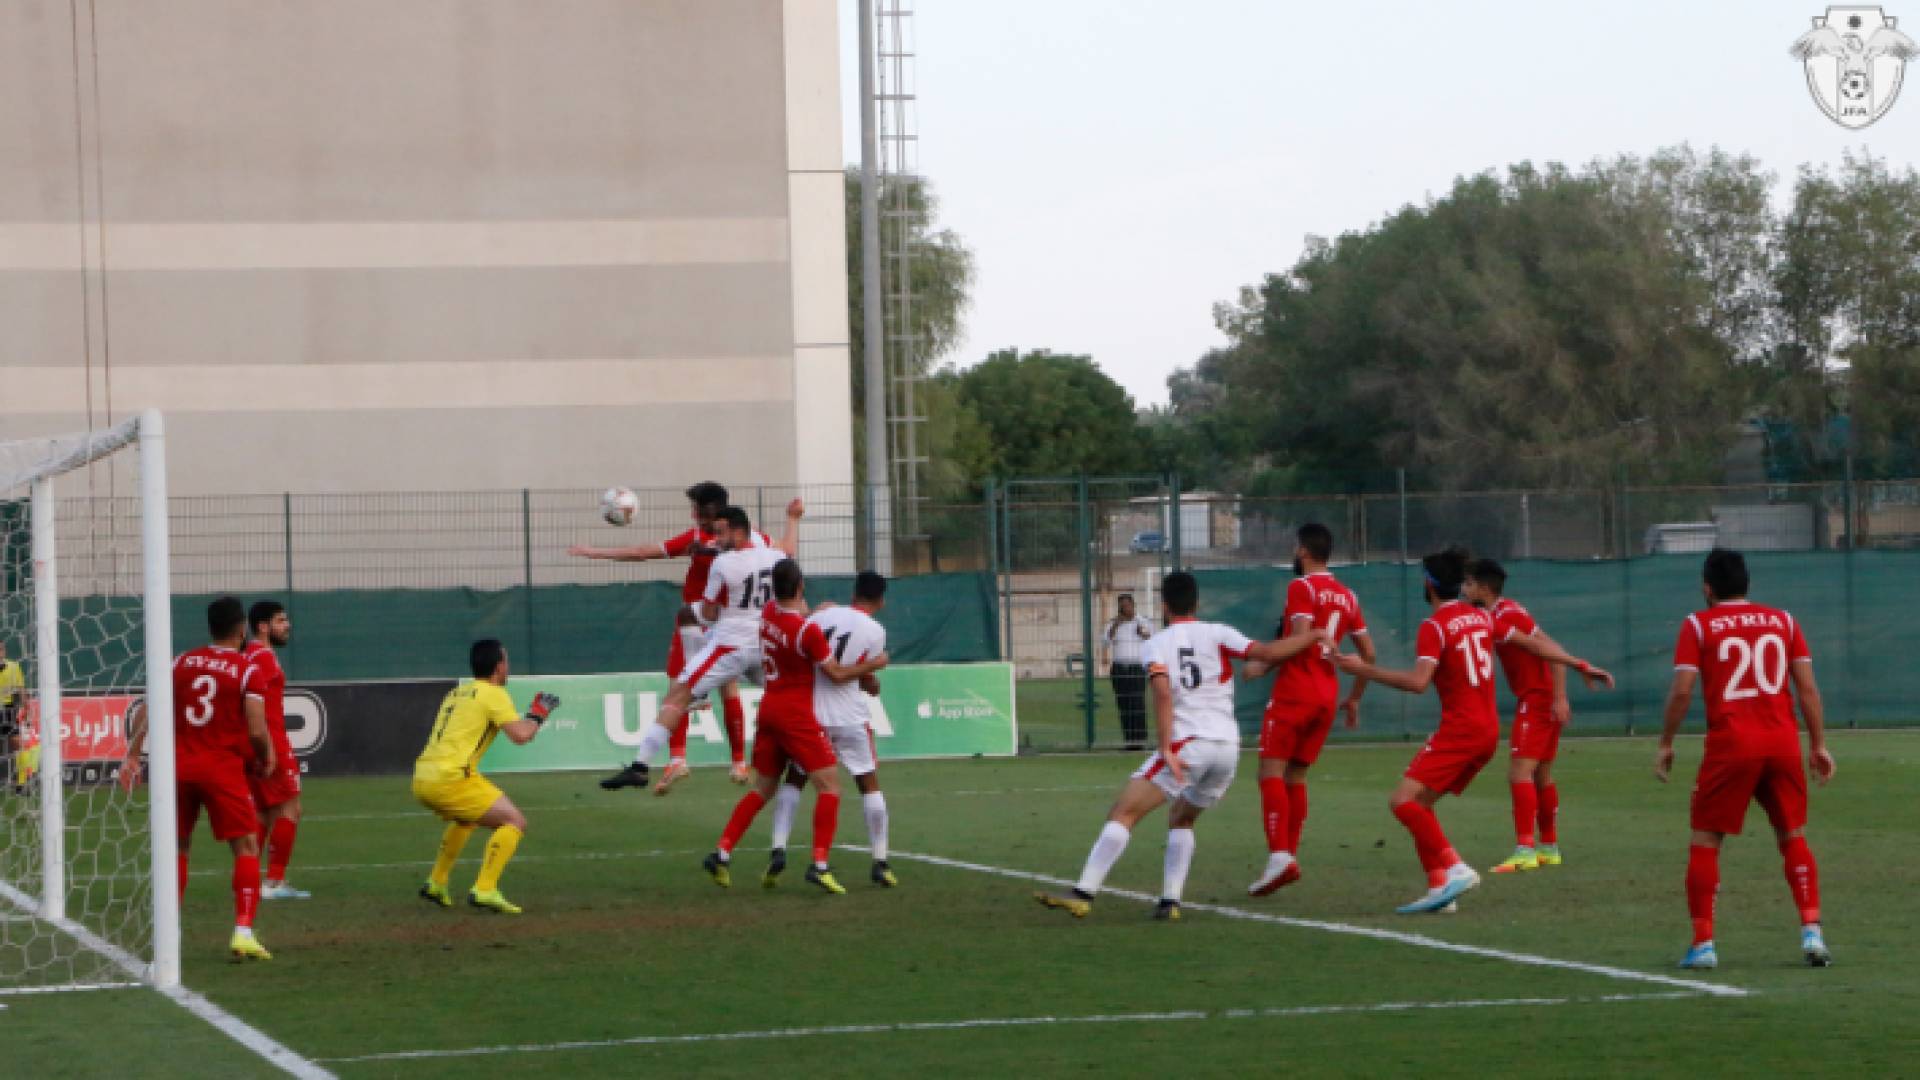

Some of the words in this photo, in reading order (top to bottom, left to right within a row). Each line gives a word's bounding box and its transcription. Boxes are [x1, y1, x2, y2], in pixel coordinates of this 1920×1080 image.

[738, 569, 773, 608] 15
[1710, 613, 1783, 633] SYRIA
[184, 654, 239, 678] SYRIA
[1177, 646, 1202, 689] 5
[1456, 629, 1491, 687] 15
[1718, 633, 1787, 700] 20
[184, 674, 217, 726] 3
